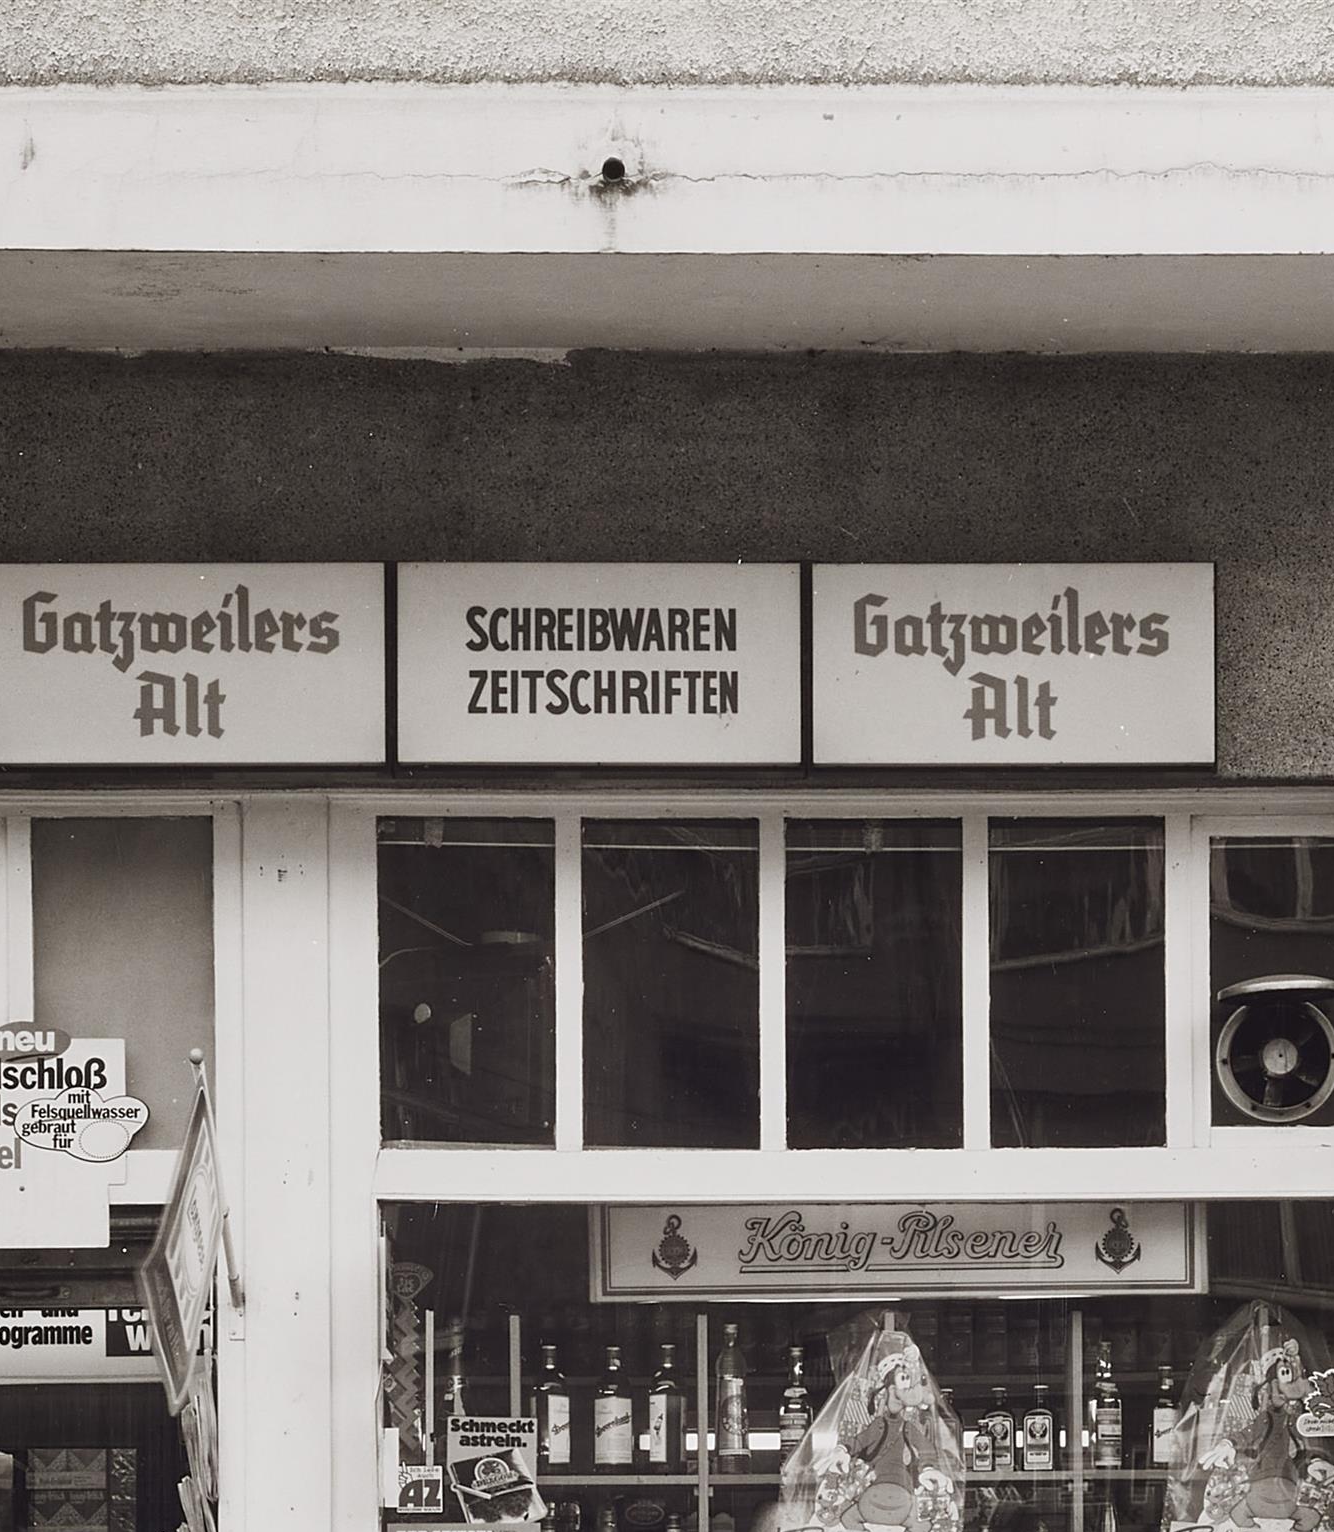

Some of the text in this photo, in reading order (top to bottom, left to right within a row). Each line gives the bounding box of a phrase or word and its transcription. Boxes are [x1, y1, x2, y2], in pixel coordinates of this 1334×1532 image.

[21, 587, 341, 676] Gatzweilers
[465, 605, 737, 654] SCHREIBWAREN
[853, 590, 1170, 678] Gatzweilers
[132, 670, 227, 742] Alt
[467, 670, 739, 716] ZEITSCHRIFTEN
[963, 672, 1058, 742] Alt
[67, 1090, 91, 1104] mit
[30, 1104, 141, 1121] Felsquellwasser
[21, 1120, 76, 1136] gebraut
[52, 1136, 74, 1149] für
[450, 1418, 535, 1434] Schmeckt
[458, 1433, 527, 1448] astrein.
[399, 1479, 441, 1507] AZ
